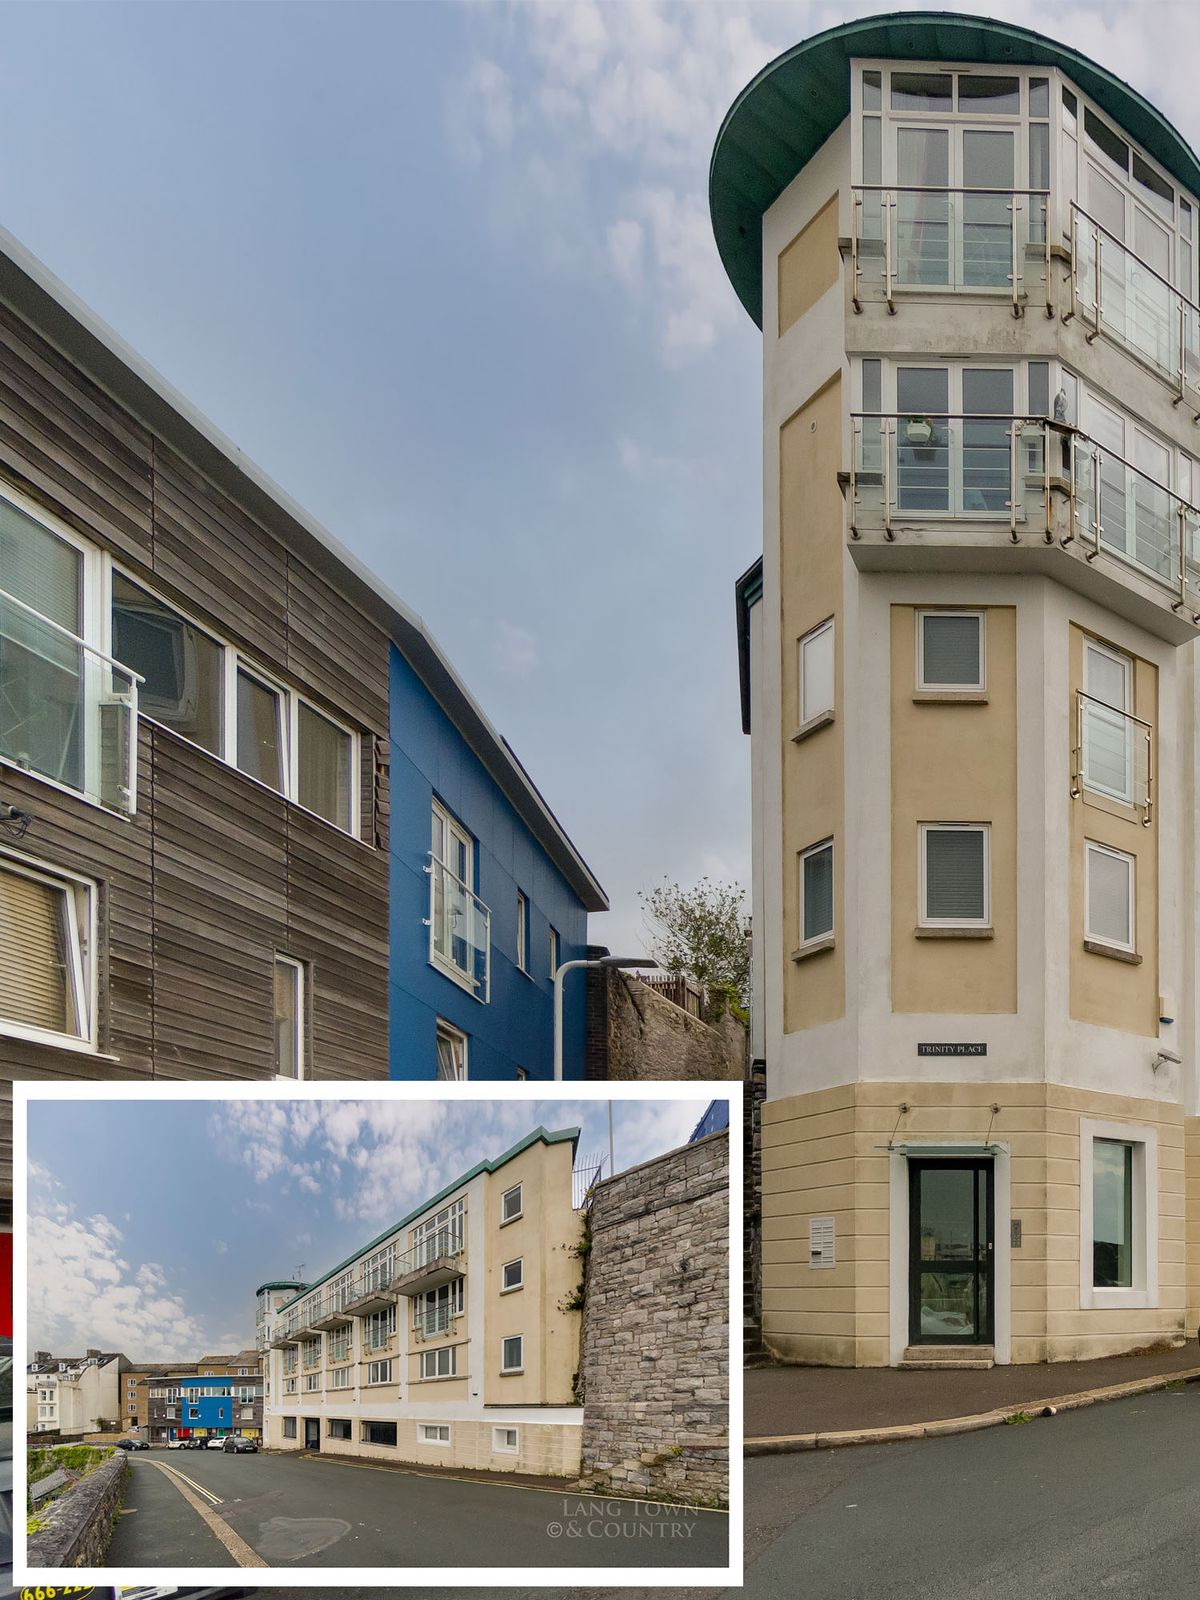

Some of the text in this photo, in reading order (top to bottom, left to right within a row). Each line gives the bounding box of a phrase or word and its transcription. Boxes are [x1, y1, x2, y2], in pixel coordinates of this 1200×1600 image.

[921, 1045, 984, 1053] TRINITY PLACE
[23, 1586, 93, 1600] 666-2
